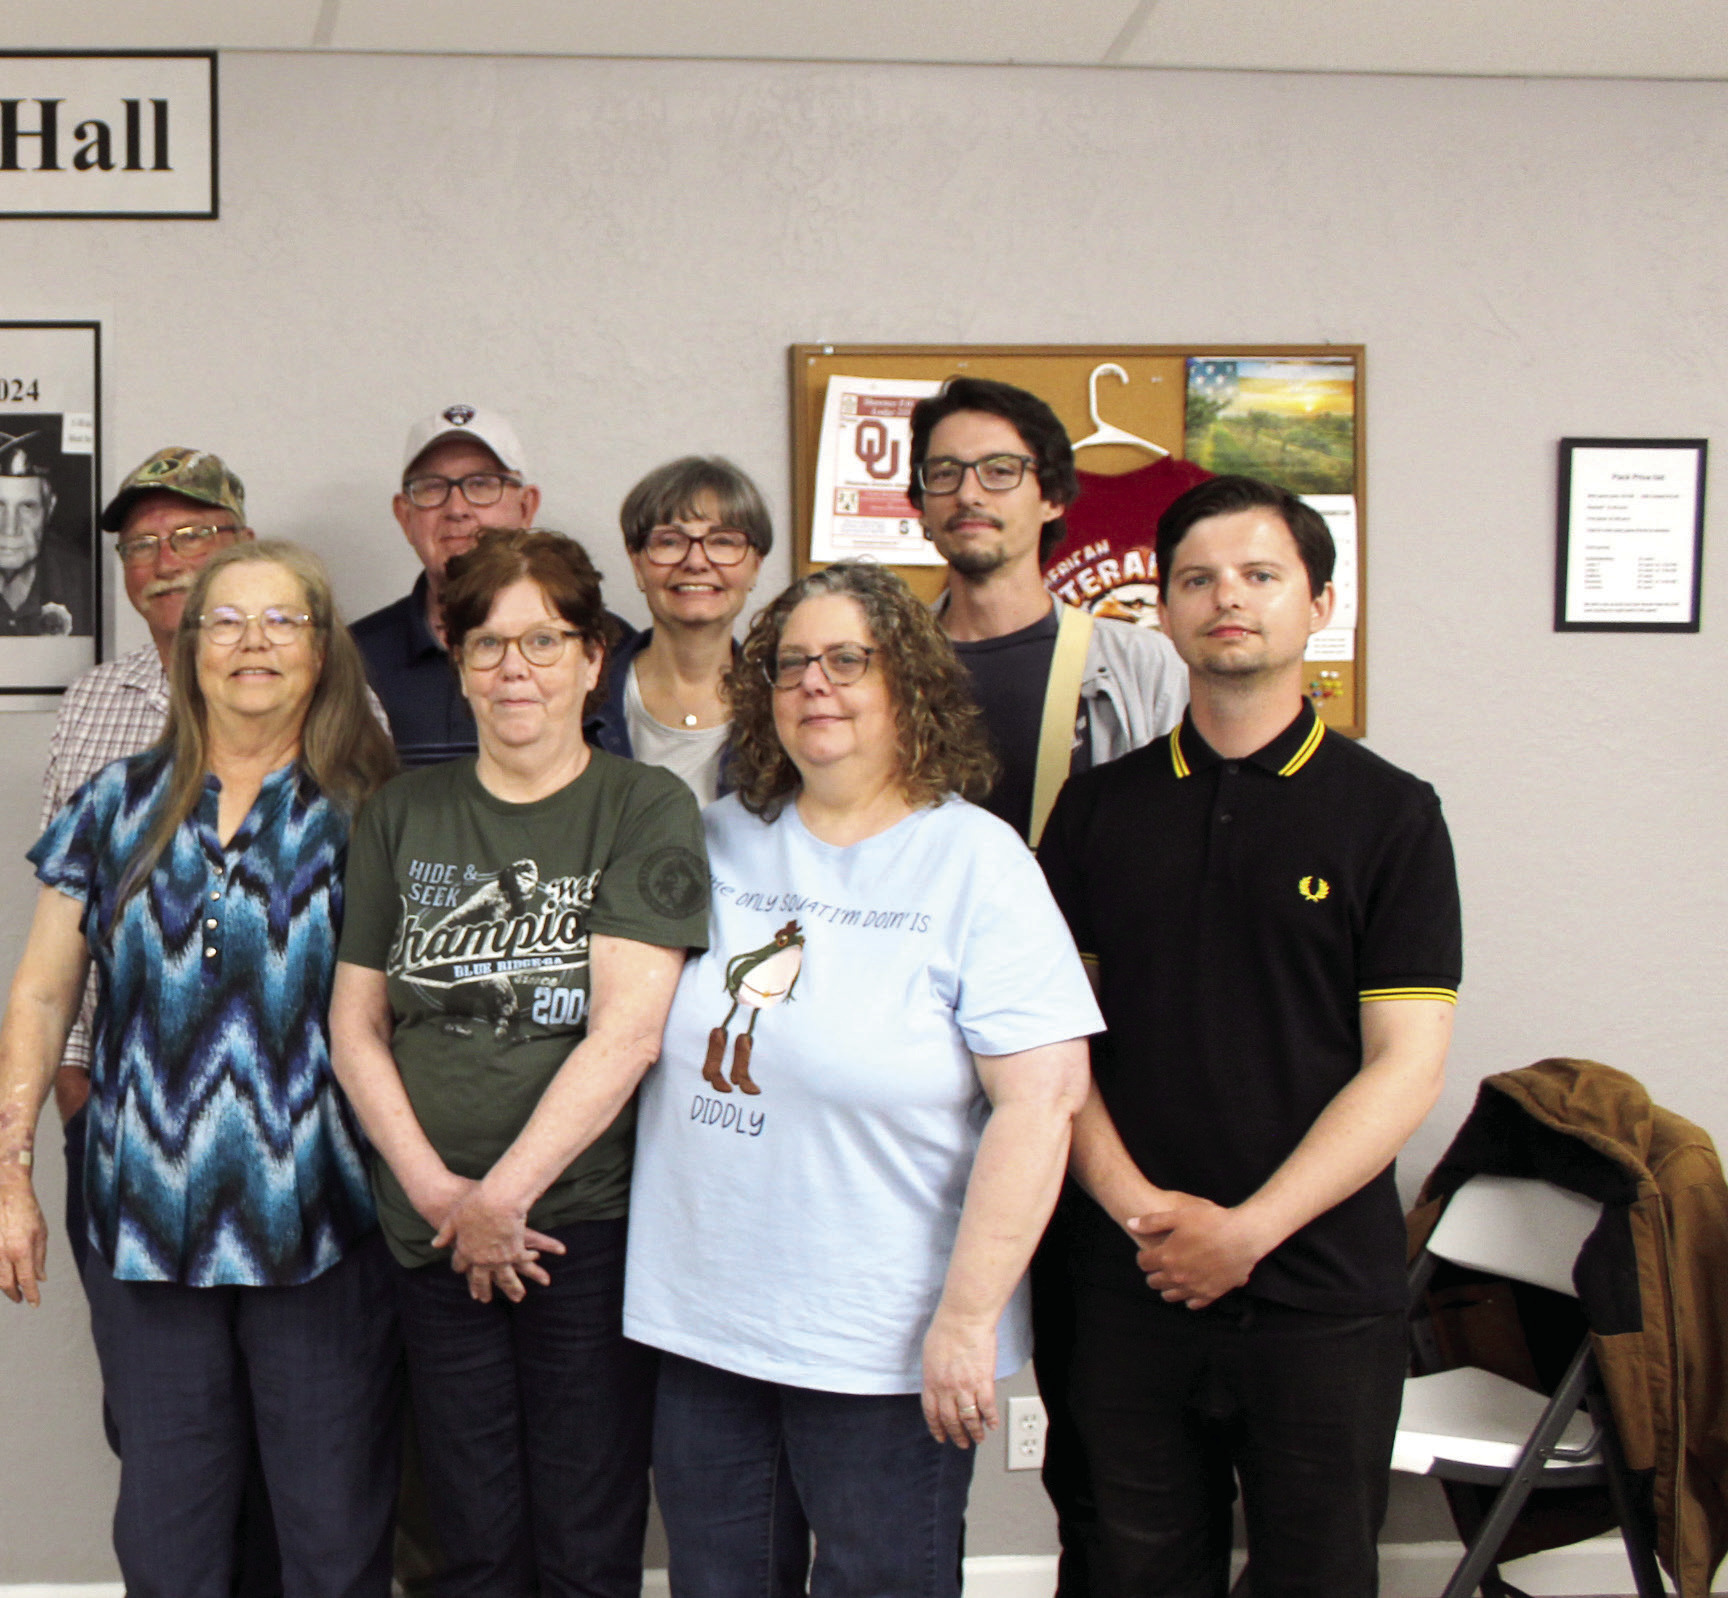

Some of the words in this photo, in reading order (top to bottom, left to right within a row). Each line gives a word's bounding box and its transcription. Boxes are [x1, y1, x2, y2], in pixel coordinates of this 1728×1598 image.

[855, 419, 899, 479] OU
[1043, 538, 1111, 586] ERICAN
[409, 859, 458, 885] HIDE
[463, 863, 477, 881] &
[408, 882, 462, 908] SEEK
[909, 911, 932, 933] IS
[453, 962, 492, 978] BLUE
[532, 985, 589, 1026] 200
